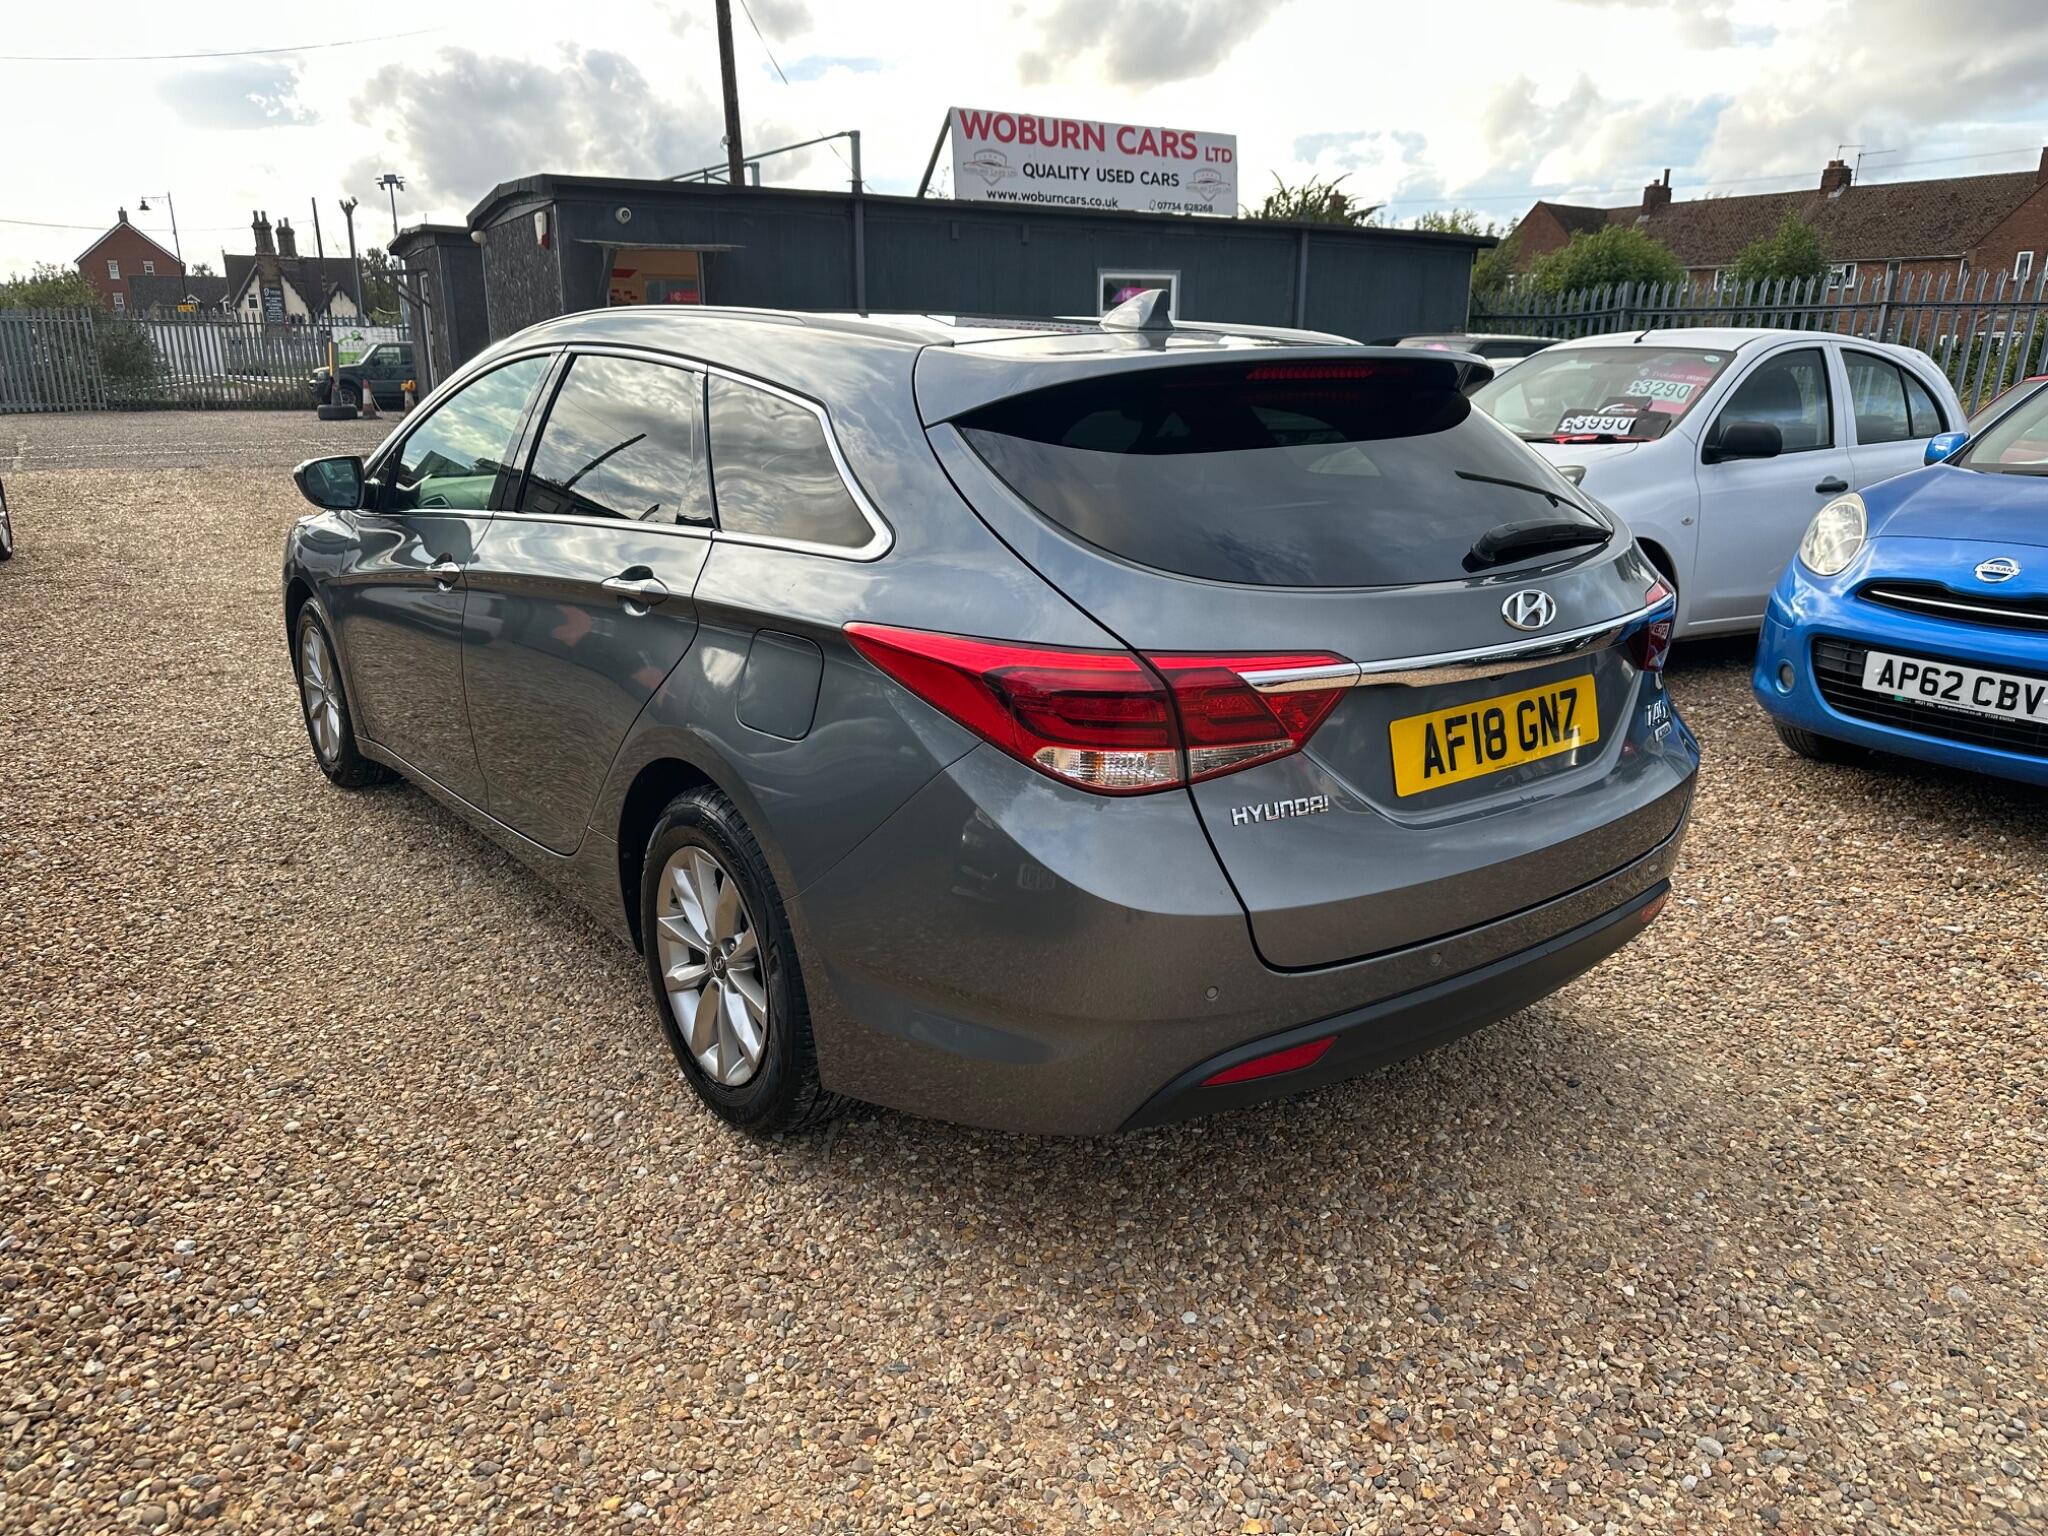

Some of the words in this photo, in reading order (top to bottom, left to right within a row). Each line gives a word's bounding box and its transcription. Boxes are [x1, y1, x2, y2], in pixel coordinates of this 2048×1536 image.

[959, 110, 1105, 152] WOBURN
[1116, 127, 1198, 160] CARS
[1205, 146, 1232, 164] LTD
[1023, 162, 1090, 182] QUALITY
[1097, 166, 1135, 184] USED
[1140, 171, 1180, 188] CARS
[986, 188, 1118, 209] www.woburncars.co.uk
[1625, 380, 1692, 400] £3290
[1558, 414, 1634, 433] £3990
[1980, 564, 2015, 574] NISSAN
[1877, 659, 1964, 702] AP62
[1972, 676, 2047, 716] CBV
[1423, 714, 1508, 780] AF18
[1517, 688, 1581, 753] GNZ
[1231, 794, 1330, 826] HYUNDAI
